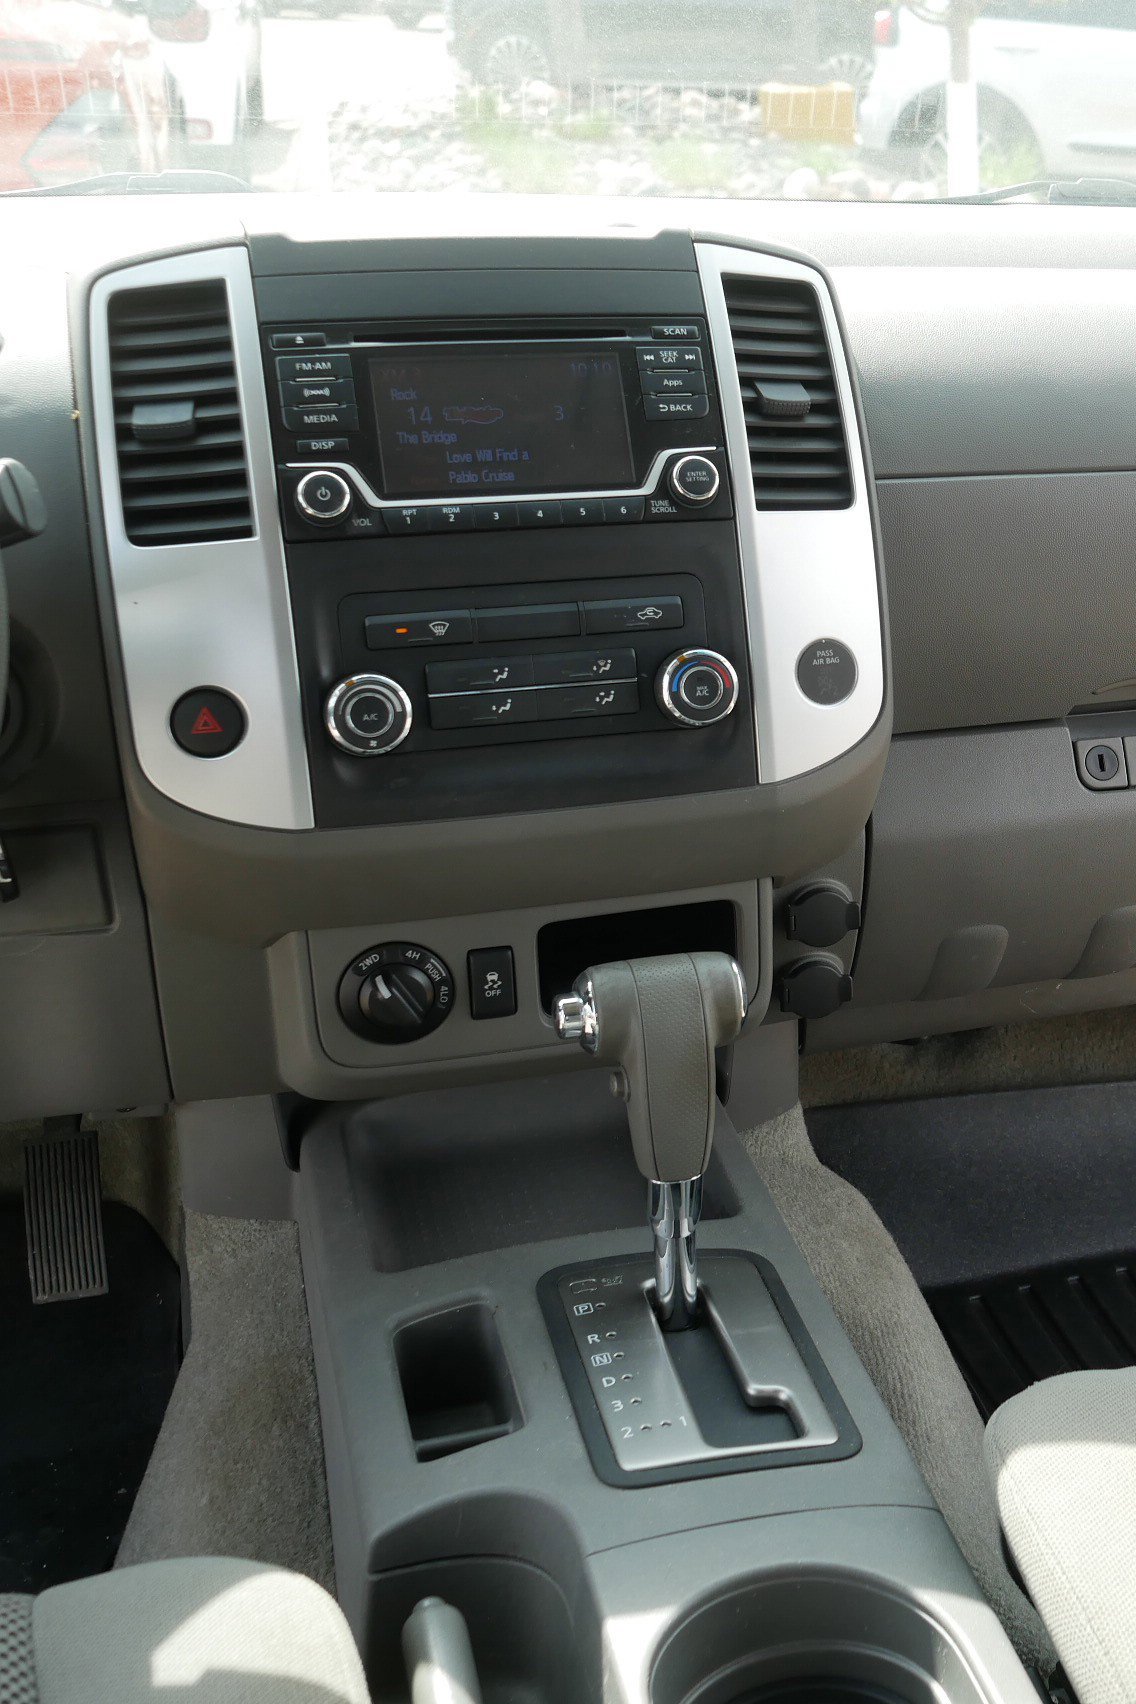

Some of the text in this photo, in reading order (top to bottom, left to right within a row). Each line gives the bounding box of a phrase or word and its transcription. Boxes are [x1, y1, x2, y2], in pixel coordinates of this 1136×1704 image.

[664, 328, 688, 336] SCAN
[663, 379, 683, 387] Apps
[390, 387, 417, 400] Rock
[407, 406, 433, 424] 14
[553, 405, 564, 421] 3
[303, 414, 339, 423] MEDIA
[396, 430, 458, 445] The Bridge
[311, 441, 335, 450] DISP
[446, 447, 530, 463] Love Will Find a
[449, 468, 515, 483] Pablo Cruise
[537, 510, 544, 518] 4
[580, 507, 586, 516] 5
[620, 506, 627, 514] 6
[651, 506, 678, 514] SCROLL
[406, 516, 411, 524] 1
[448, 514, 455, 522] 2
[493, 511, 500, 520] 3
[353, 518, 373, 526] VOL
[817, 649, 834, 657] PASS
[812, 656, 840, 666] AIR BAG
[362, 713, 378, 721] A/C
[405, 950, 421, 960] 4H
[358, 953, 380, 971] 2WD
[424, 963, 442, 982] PUSH
[440, 985, 449, 1004] 4LO
[485, 990, 502, 998] OFF
[587, 1333, 601, 1344] R
[602, 1376, 616, 1388] D
[611, 1400, 624, 1412] 3
[620, 1416, 687, 1439] 2 1
